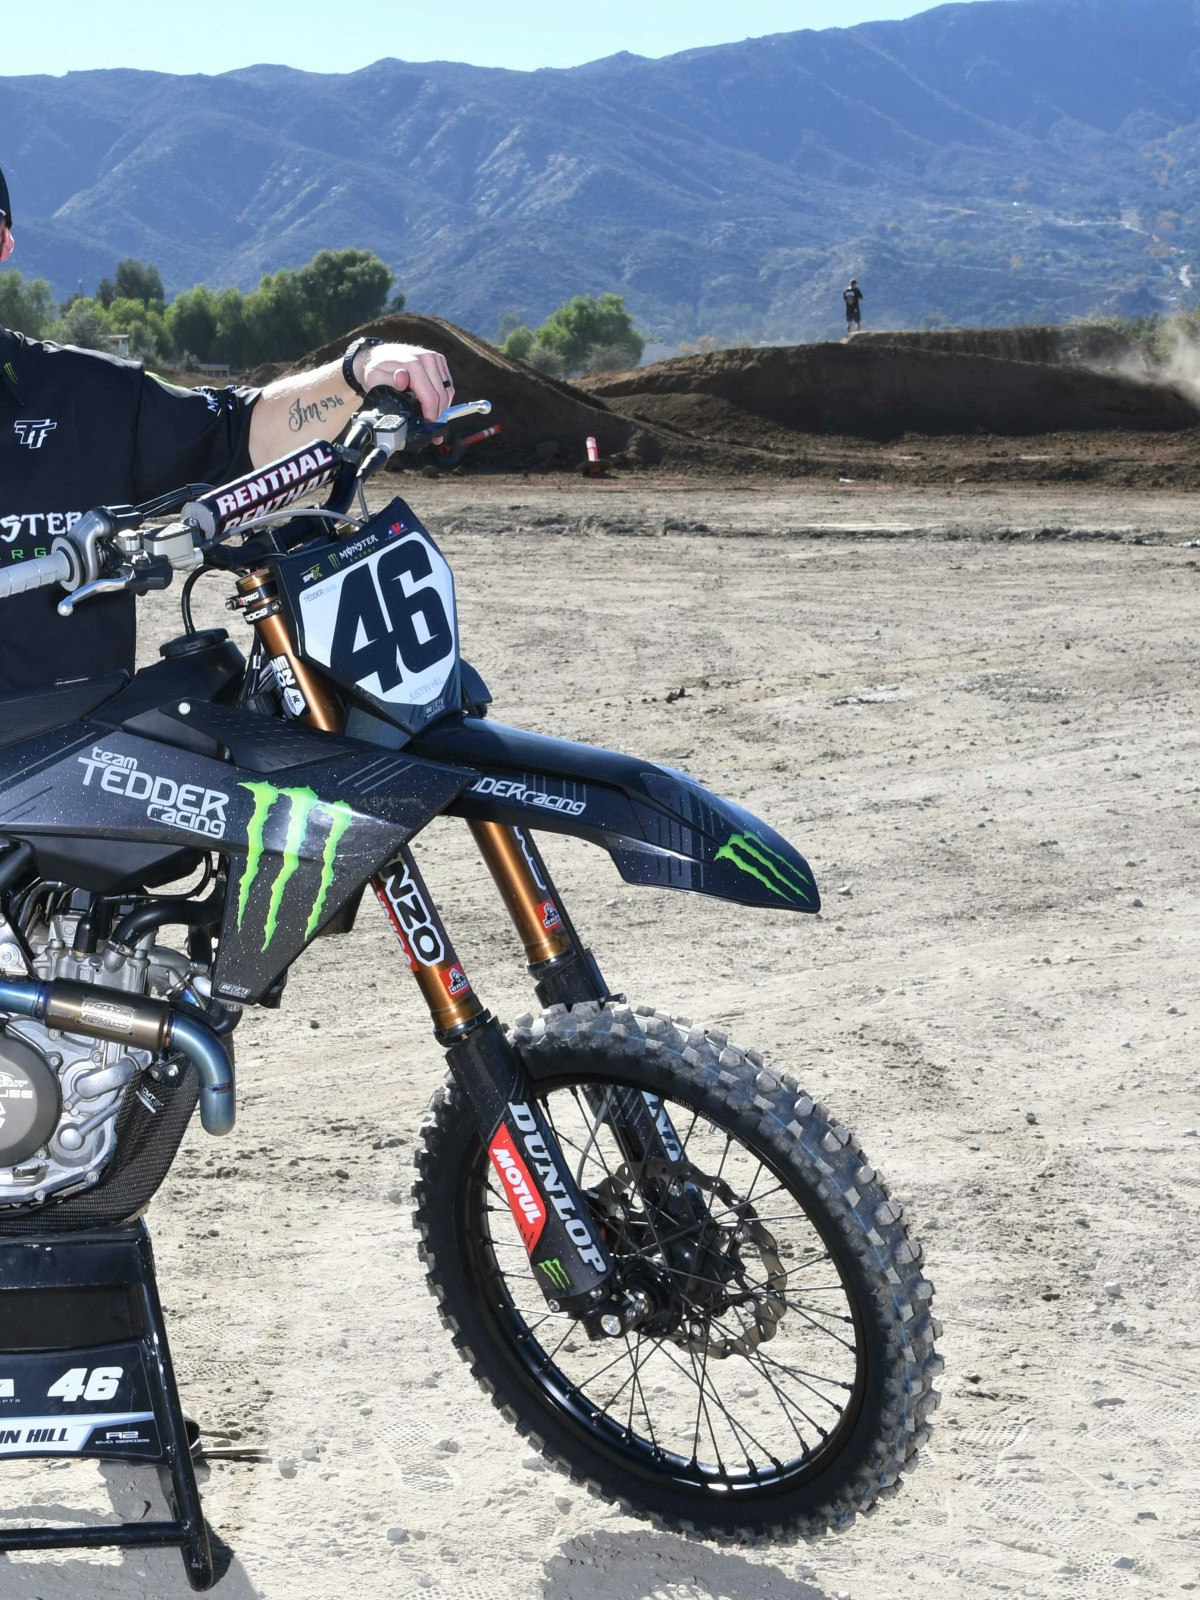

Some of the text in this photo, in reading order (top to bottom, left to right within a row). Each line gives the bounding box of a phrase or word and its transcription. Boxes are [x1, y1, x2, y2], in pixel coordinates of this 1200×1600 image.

[320, 395, 344, 410] 956
[216, 448, 333, 516] RENTHAL
[339, 534, 379, 559] MONSTER
[330, 539, 454, 694] 46
[92, 746, 138, 770] team
[78, 757, 230, 821] TEDDER
[471, 777, 527, 801] DER
[147, 803, 226, 839] racing
[379, 854, 445, 967] NZO
[492, 1148, 543, 1224] MOTUL
[507, 1102, 607, 1273] DUNLOP
[47, 1367, 124, 1402] 46
[26, 1428, 69, 1443] HILL
